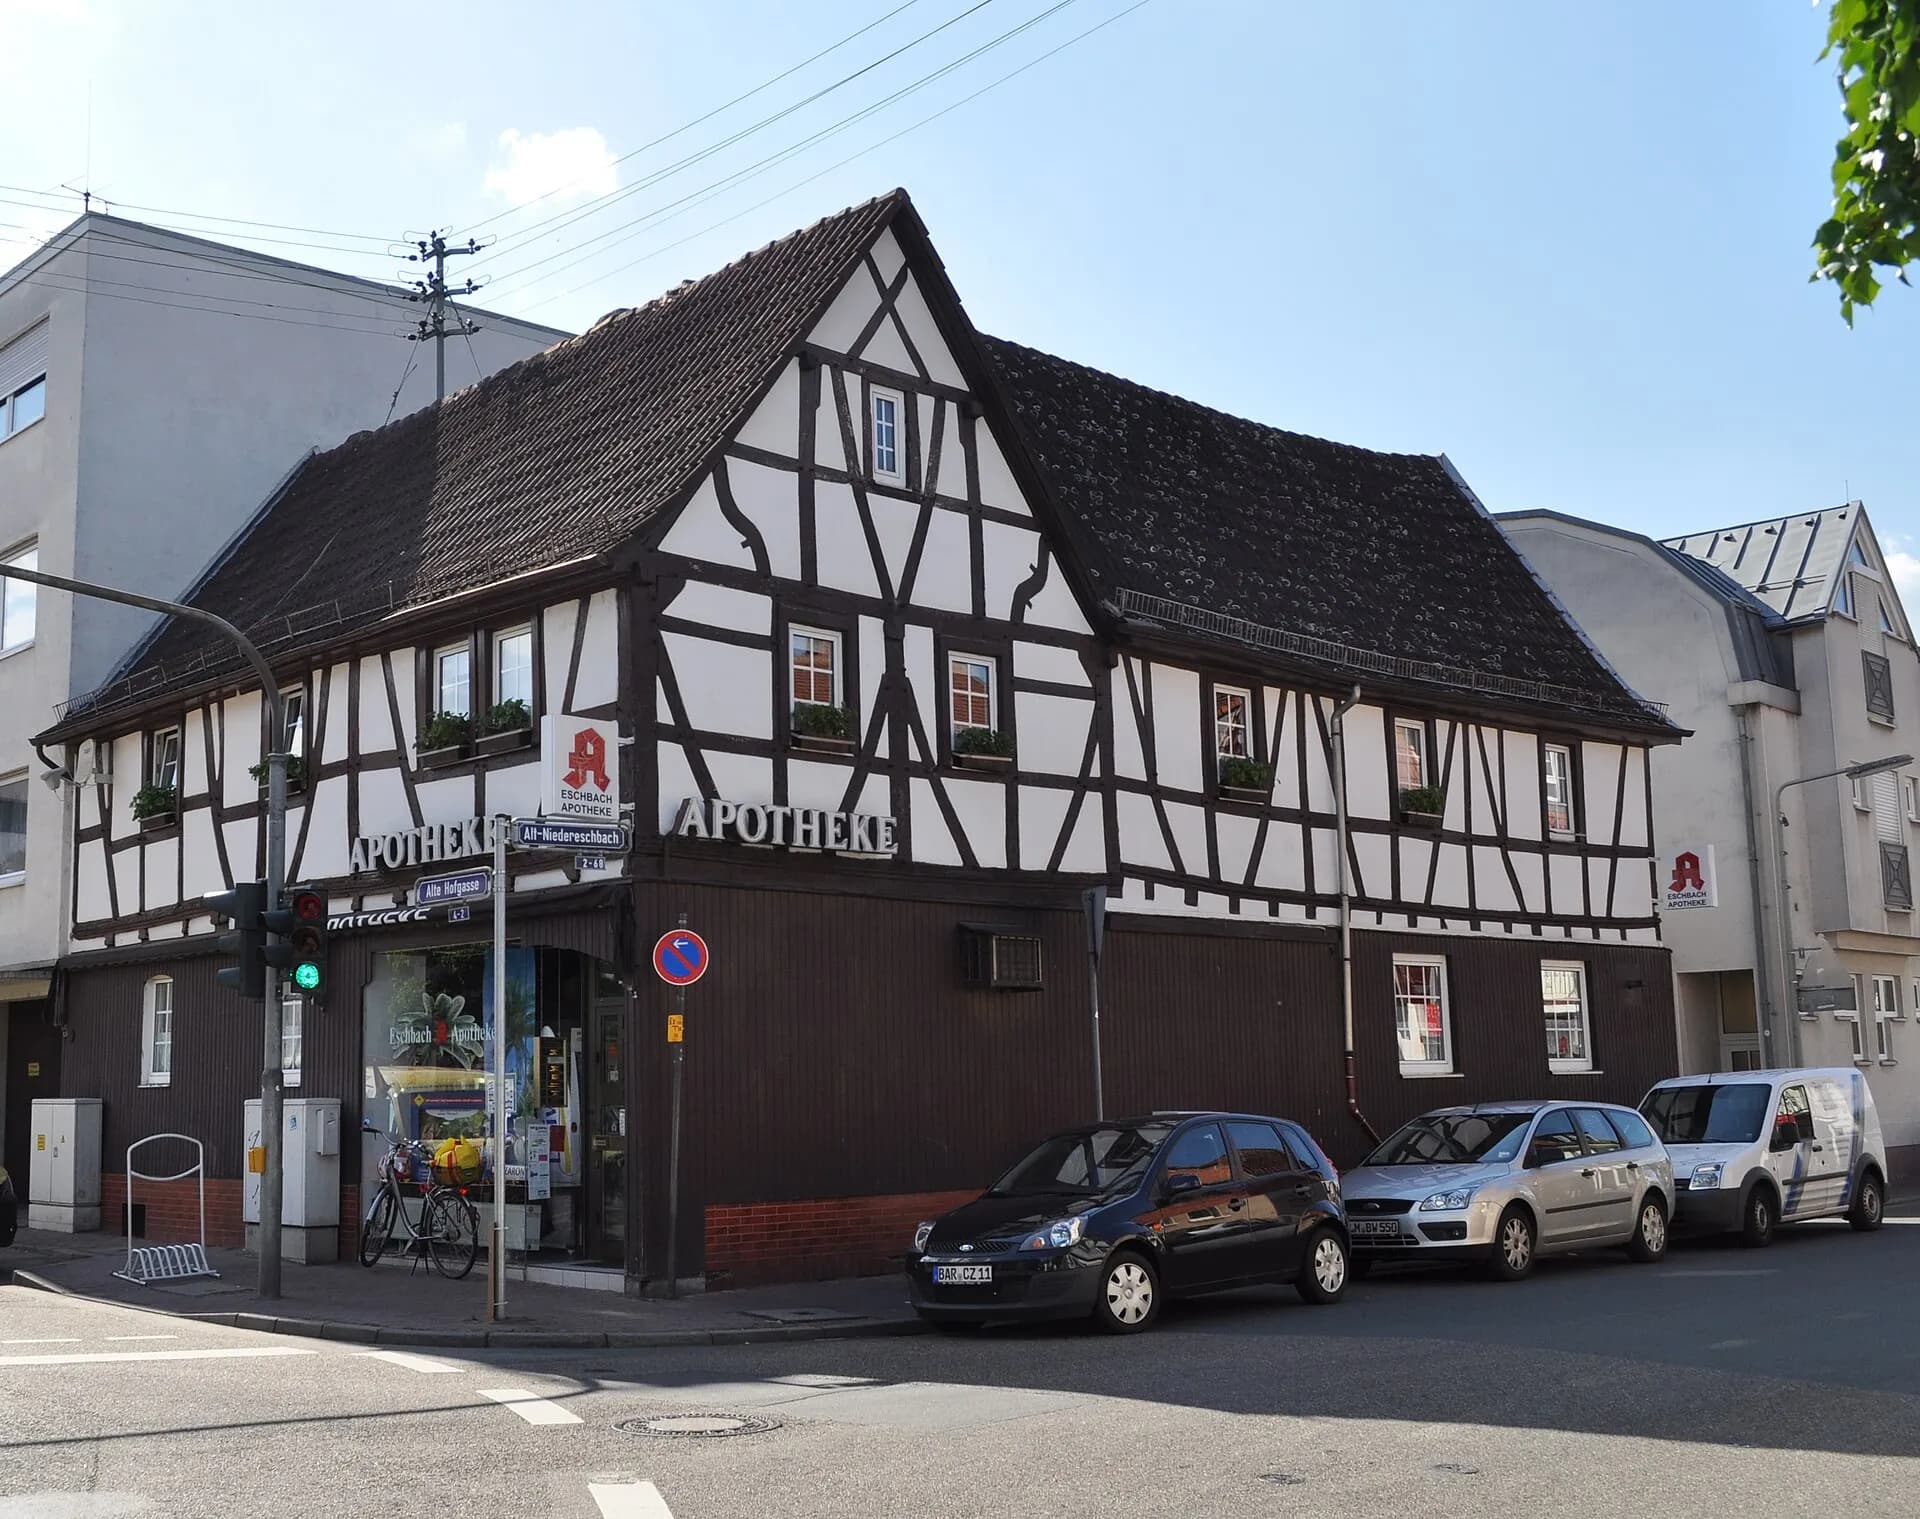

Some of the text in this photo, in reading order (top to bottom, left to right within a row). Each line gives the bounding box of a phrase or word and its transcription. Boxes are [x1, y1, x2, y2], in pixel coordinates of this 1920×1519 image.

[561, 789, 612, 804] ESCHBACH
[561, 803, 612, 816] APOTHEKE
[678, 796, 898, 854] APOTHEKE
[523, 826, 619, 844] Alt-Niedereschbach
[425, 879, 480, 898] Alte Hofgasse
[1667, 891, 1707, 900] ESCHBACH
[1668, 899, 1706, 908] APOTHEKE
[389, 1022, 496, 1045] Eschbach Apotheke
[938, 1267, 957, 1280] BAR
